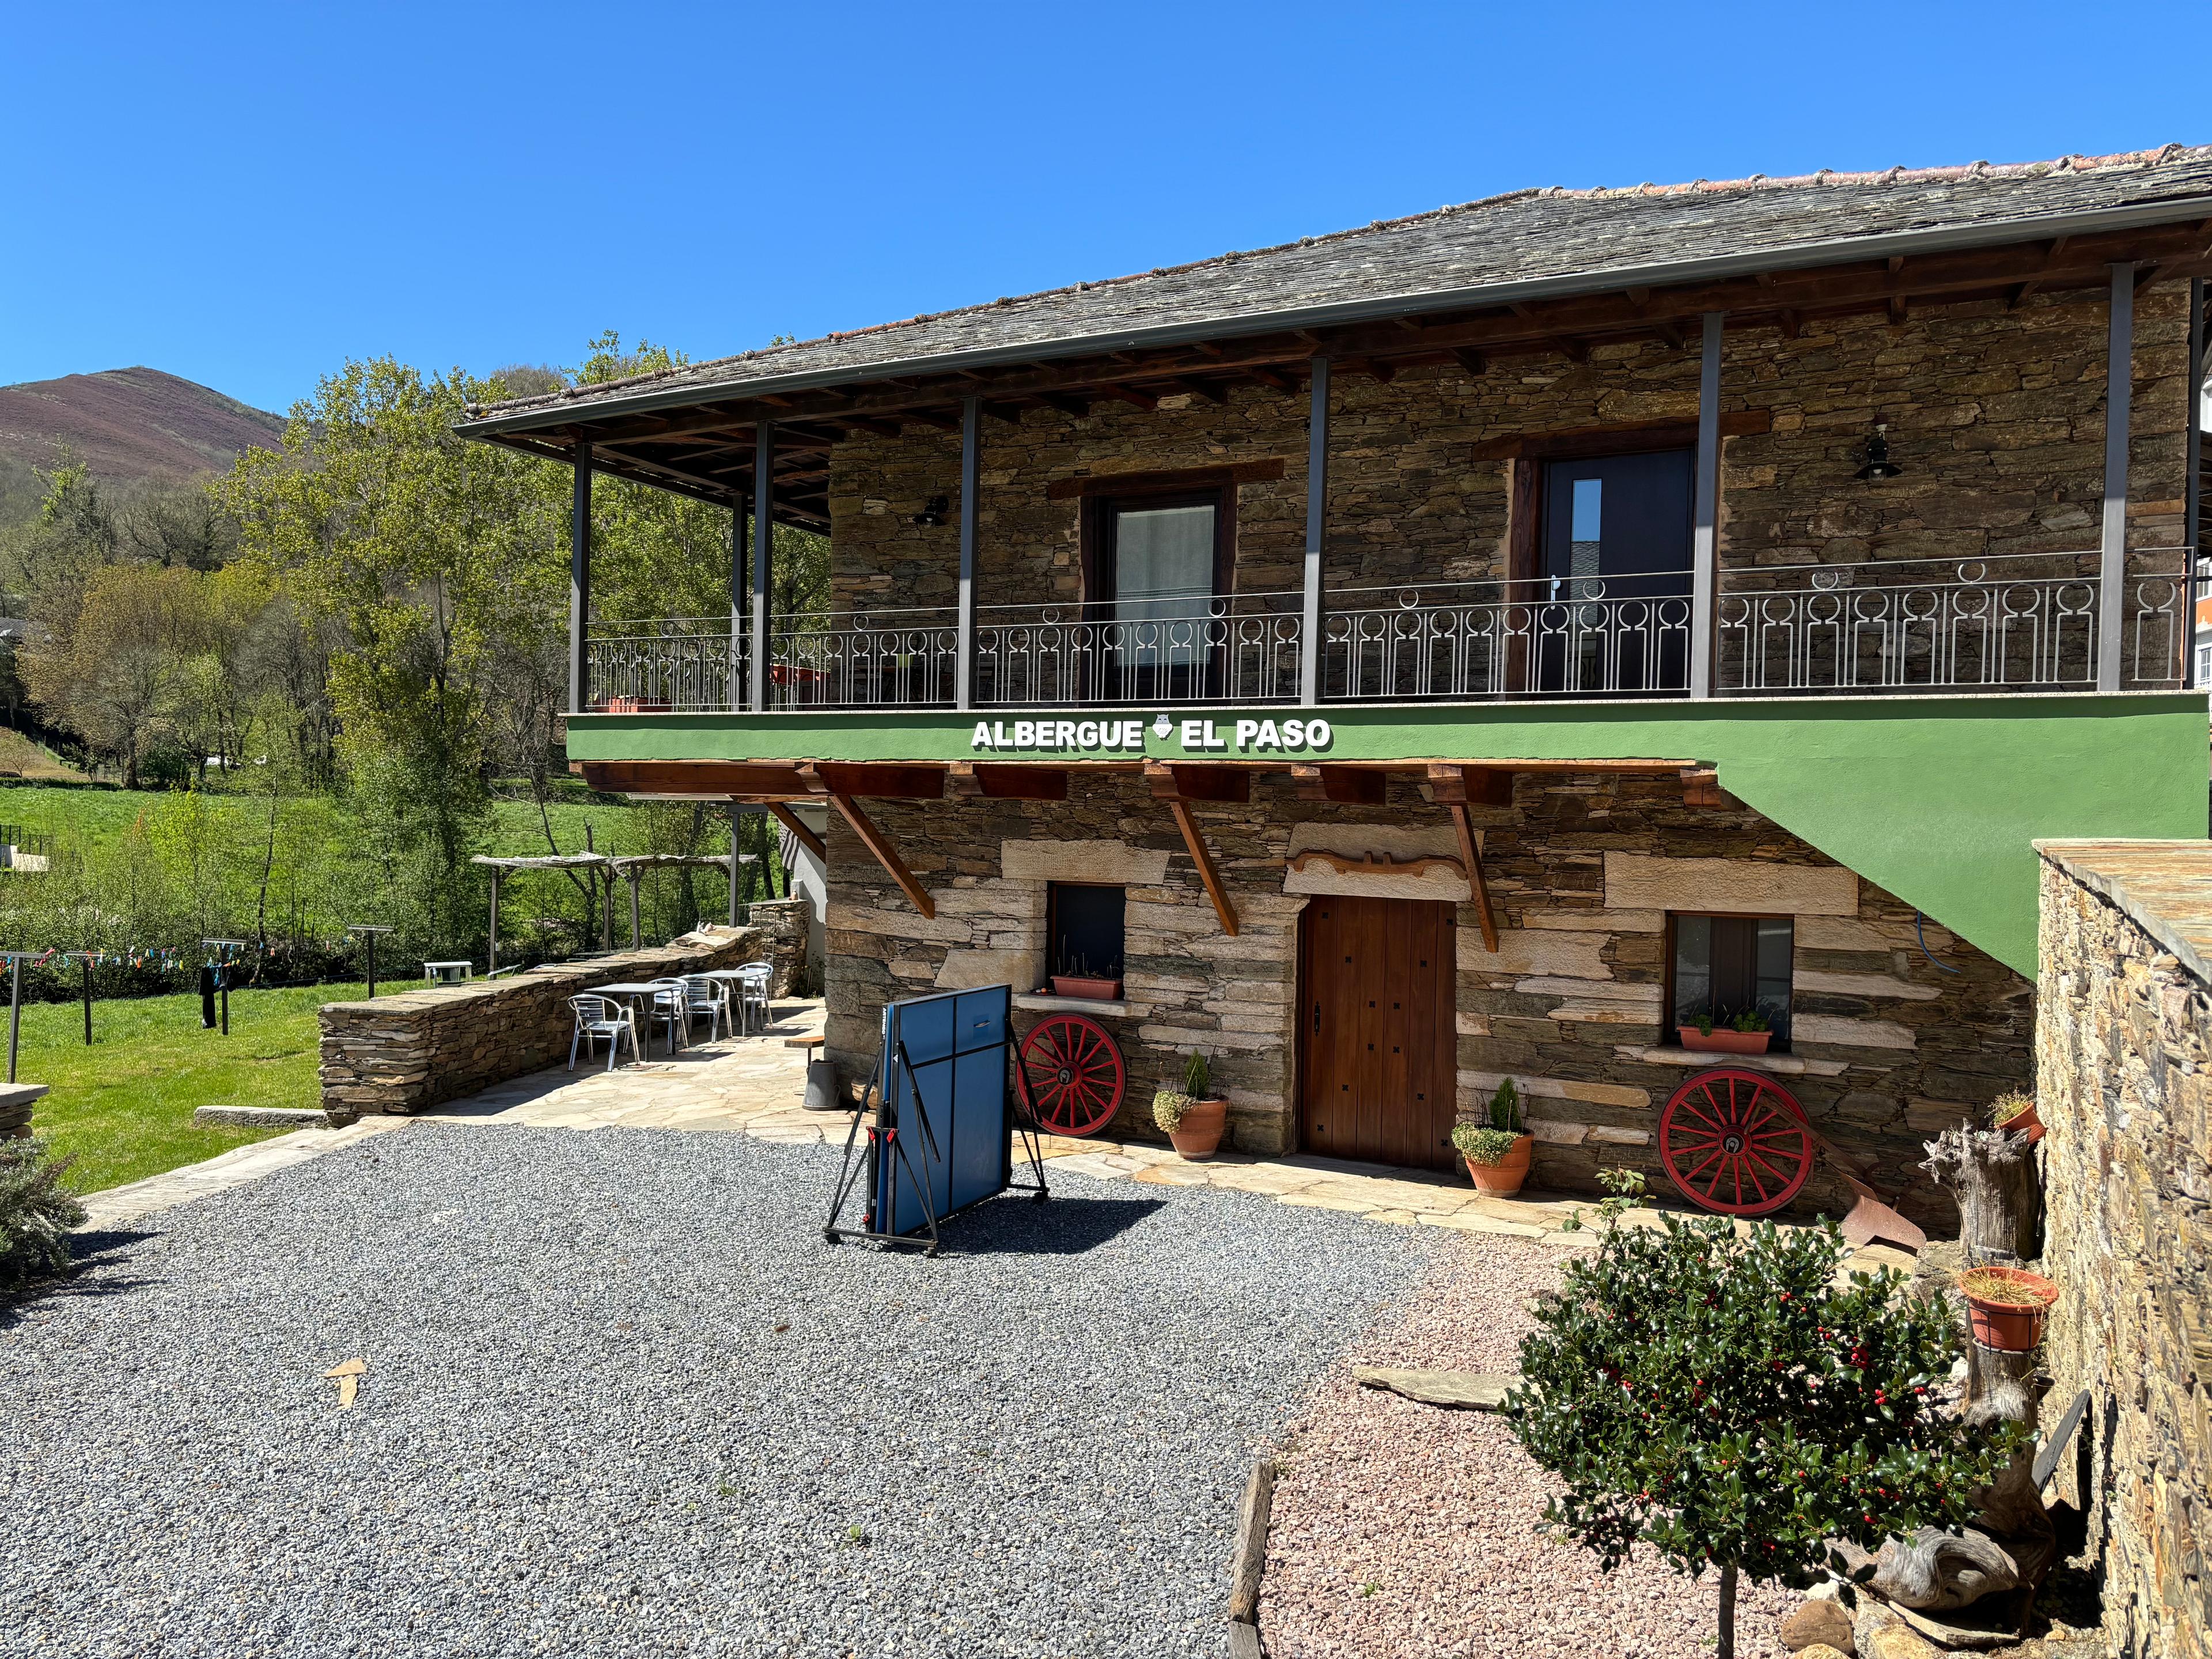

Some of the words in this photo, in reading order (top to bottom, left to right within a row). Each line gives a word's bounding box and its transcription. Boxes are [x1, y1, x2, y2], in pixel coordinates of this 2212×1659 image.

[971, 721, 1143, 747] ALBERGUE
[1181, 720, 1225, 747] EL
[1236, 719, 1331, 747] PASO
